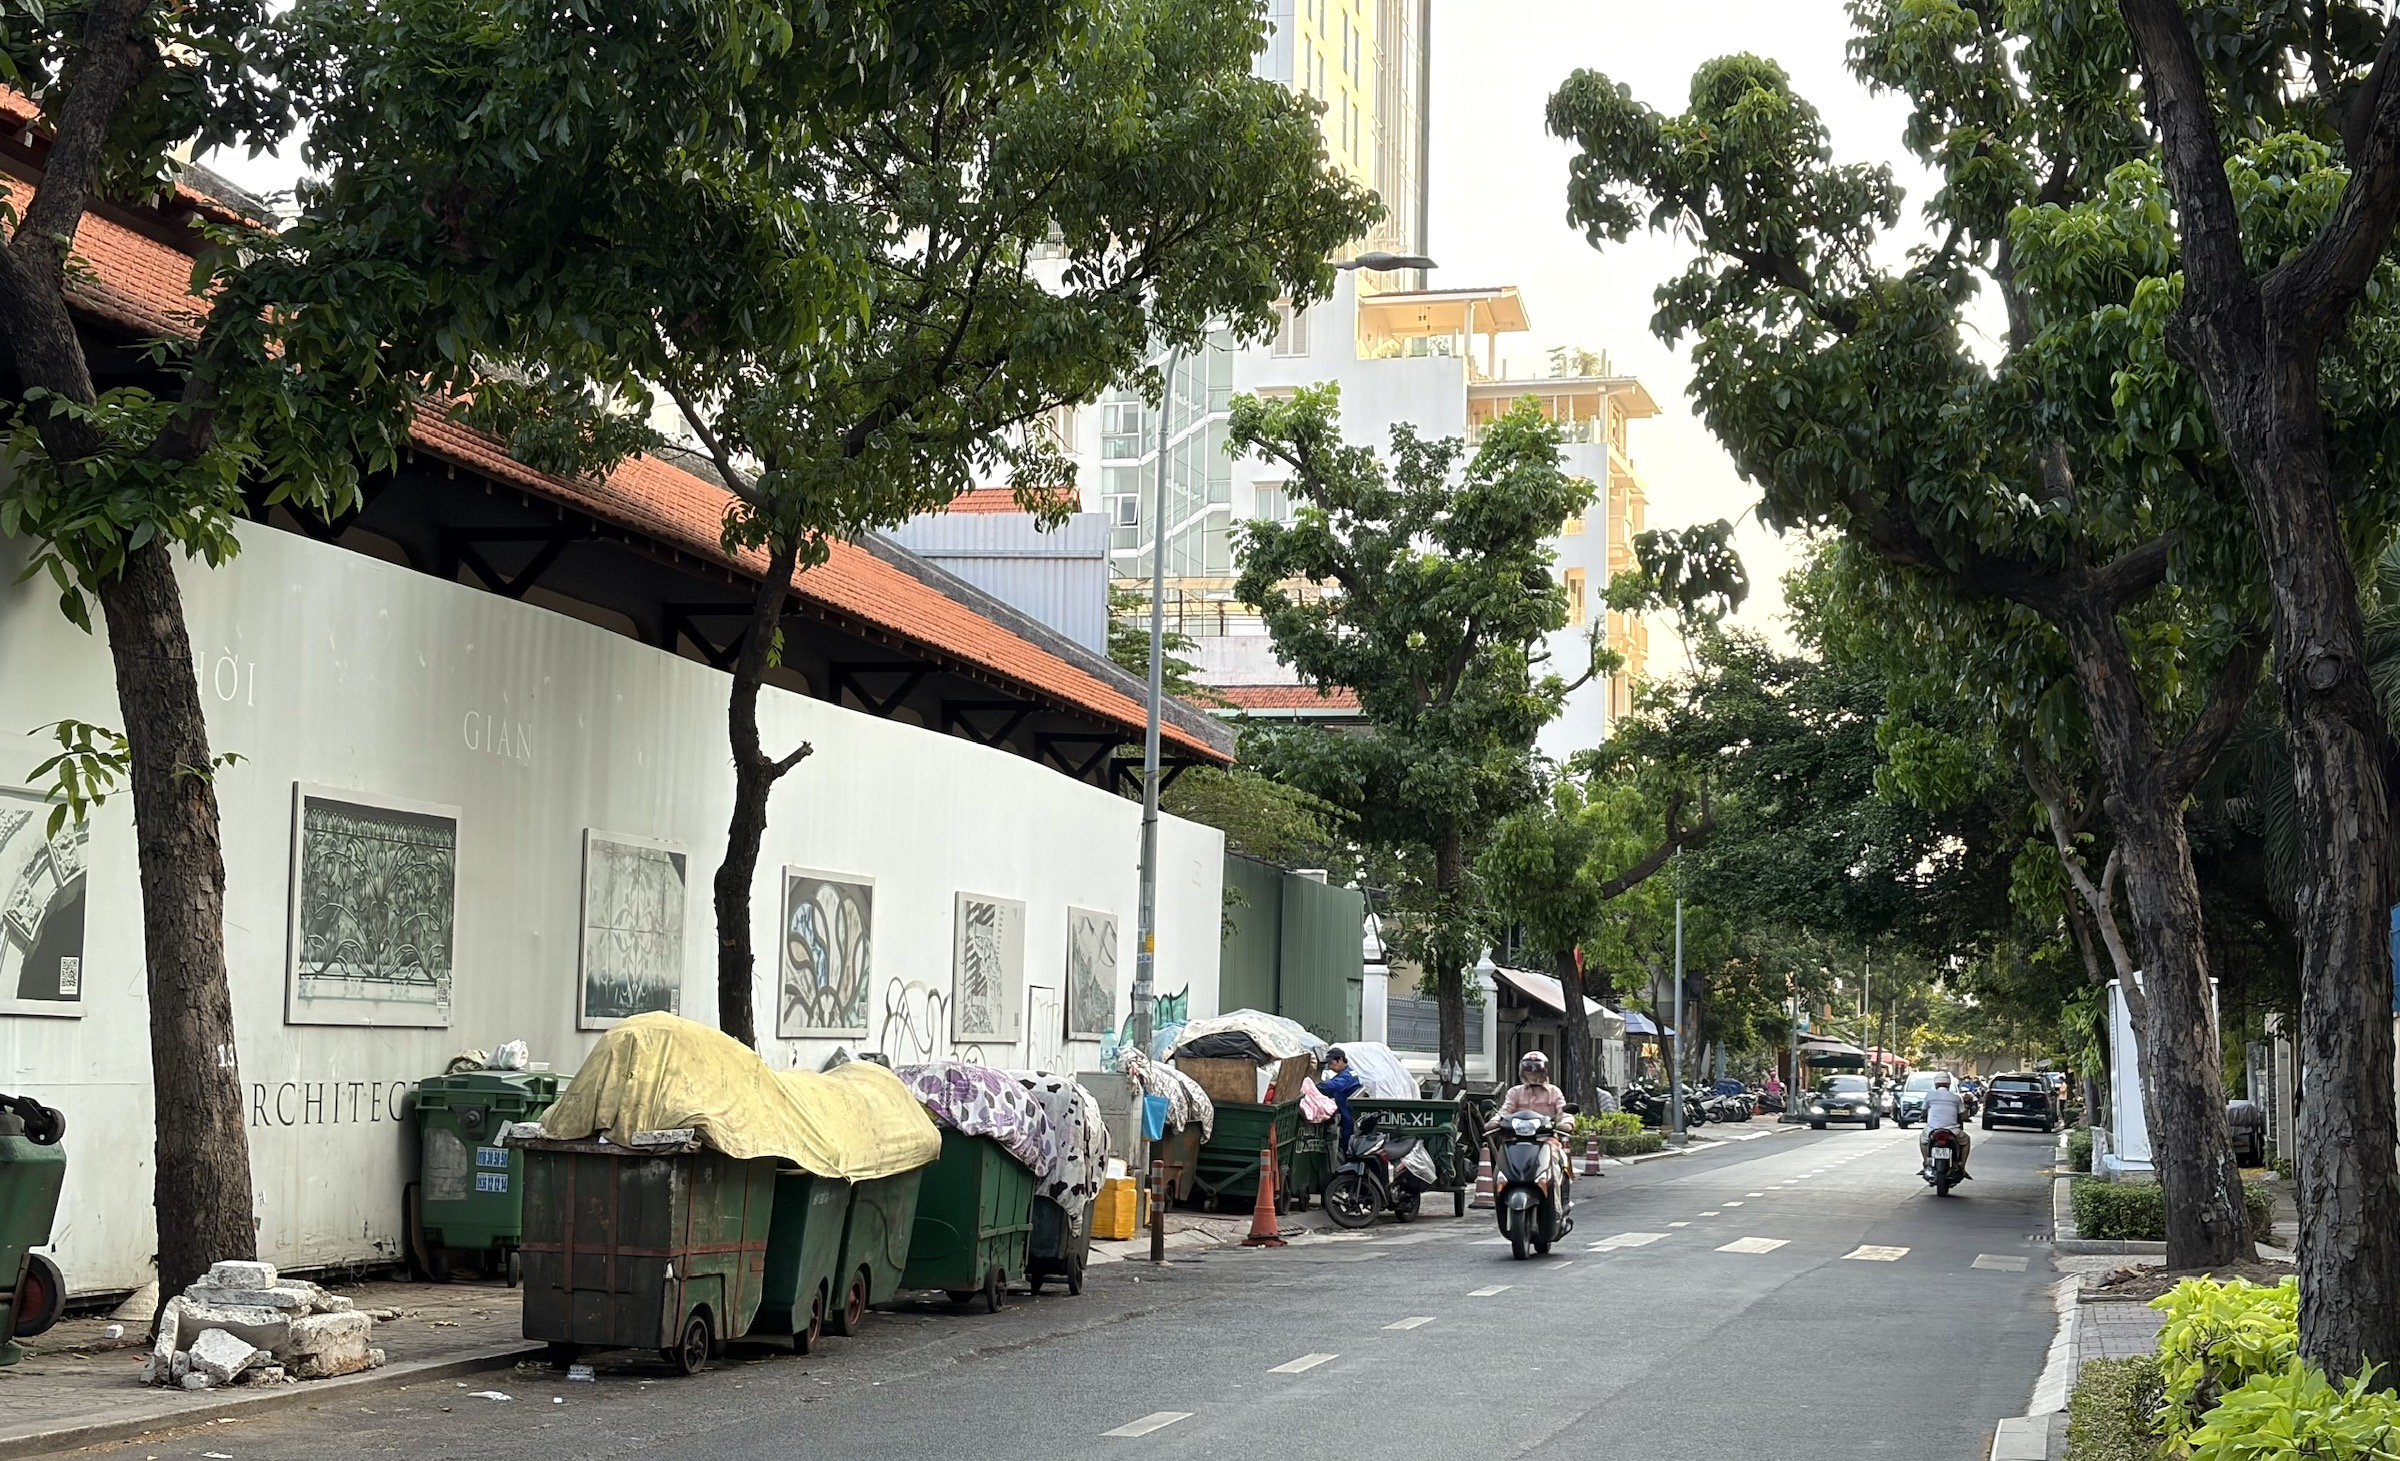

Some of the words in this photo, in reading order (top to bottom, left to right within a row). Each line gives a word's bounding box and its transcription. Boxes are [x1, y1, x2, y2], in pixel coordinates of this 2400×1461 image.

[193, 646, 256, 706] HỜI
[463, 710, 533, 760] GIAN
[251, 1081, 422, 1127] RCHITEC
